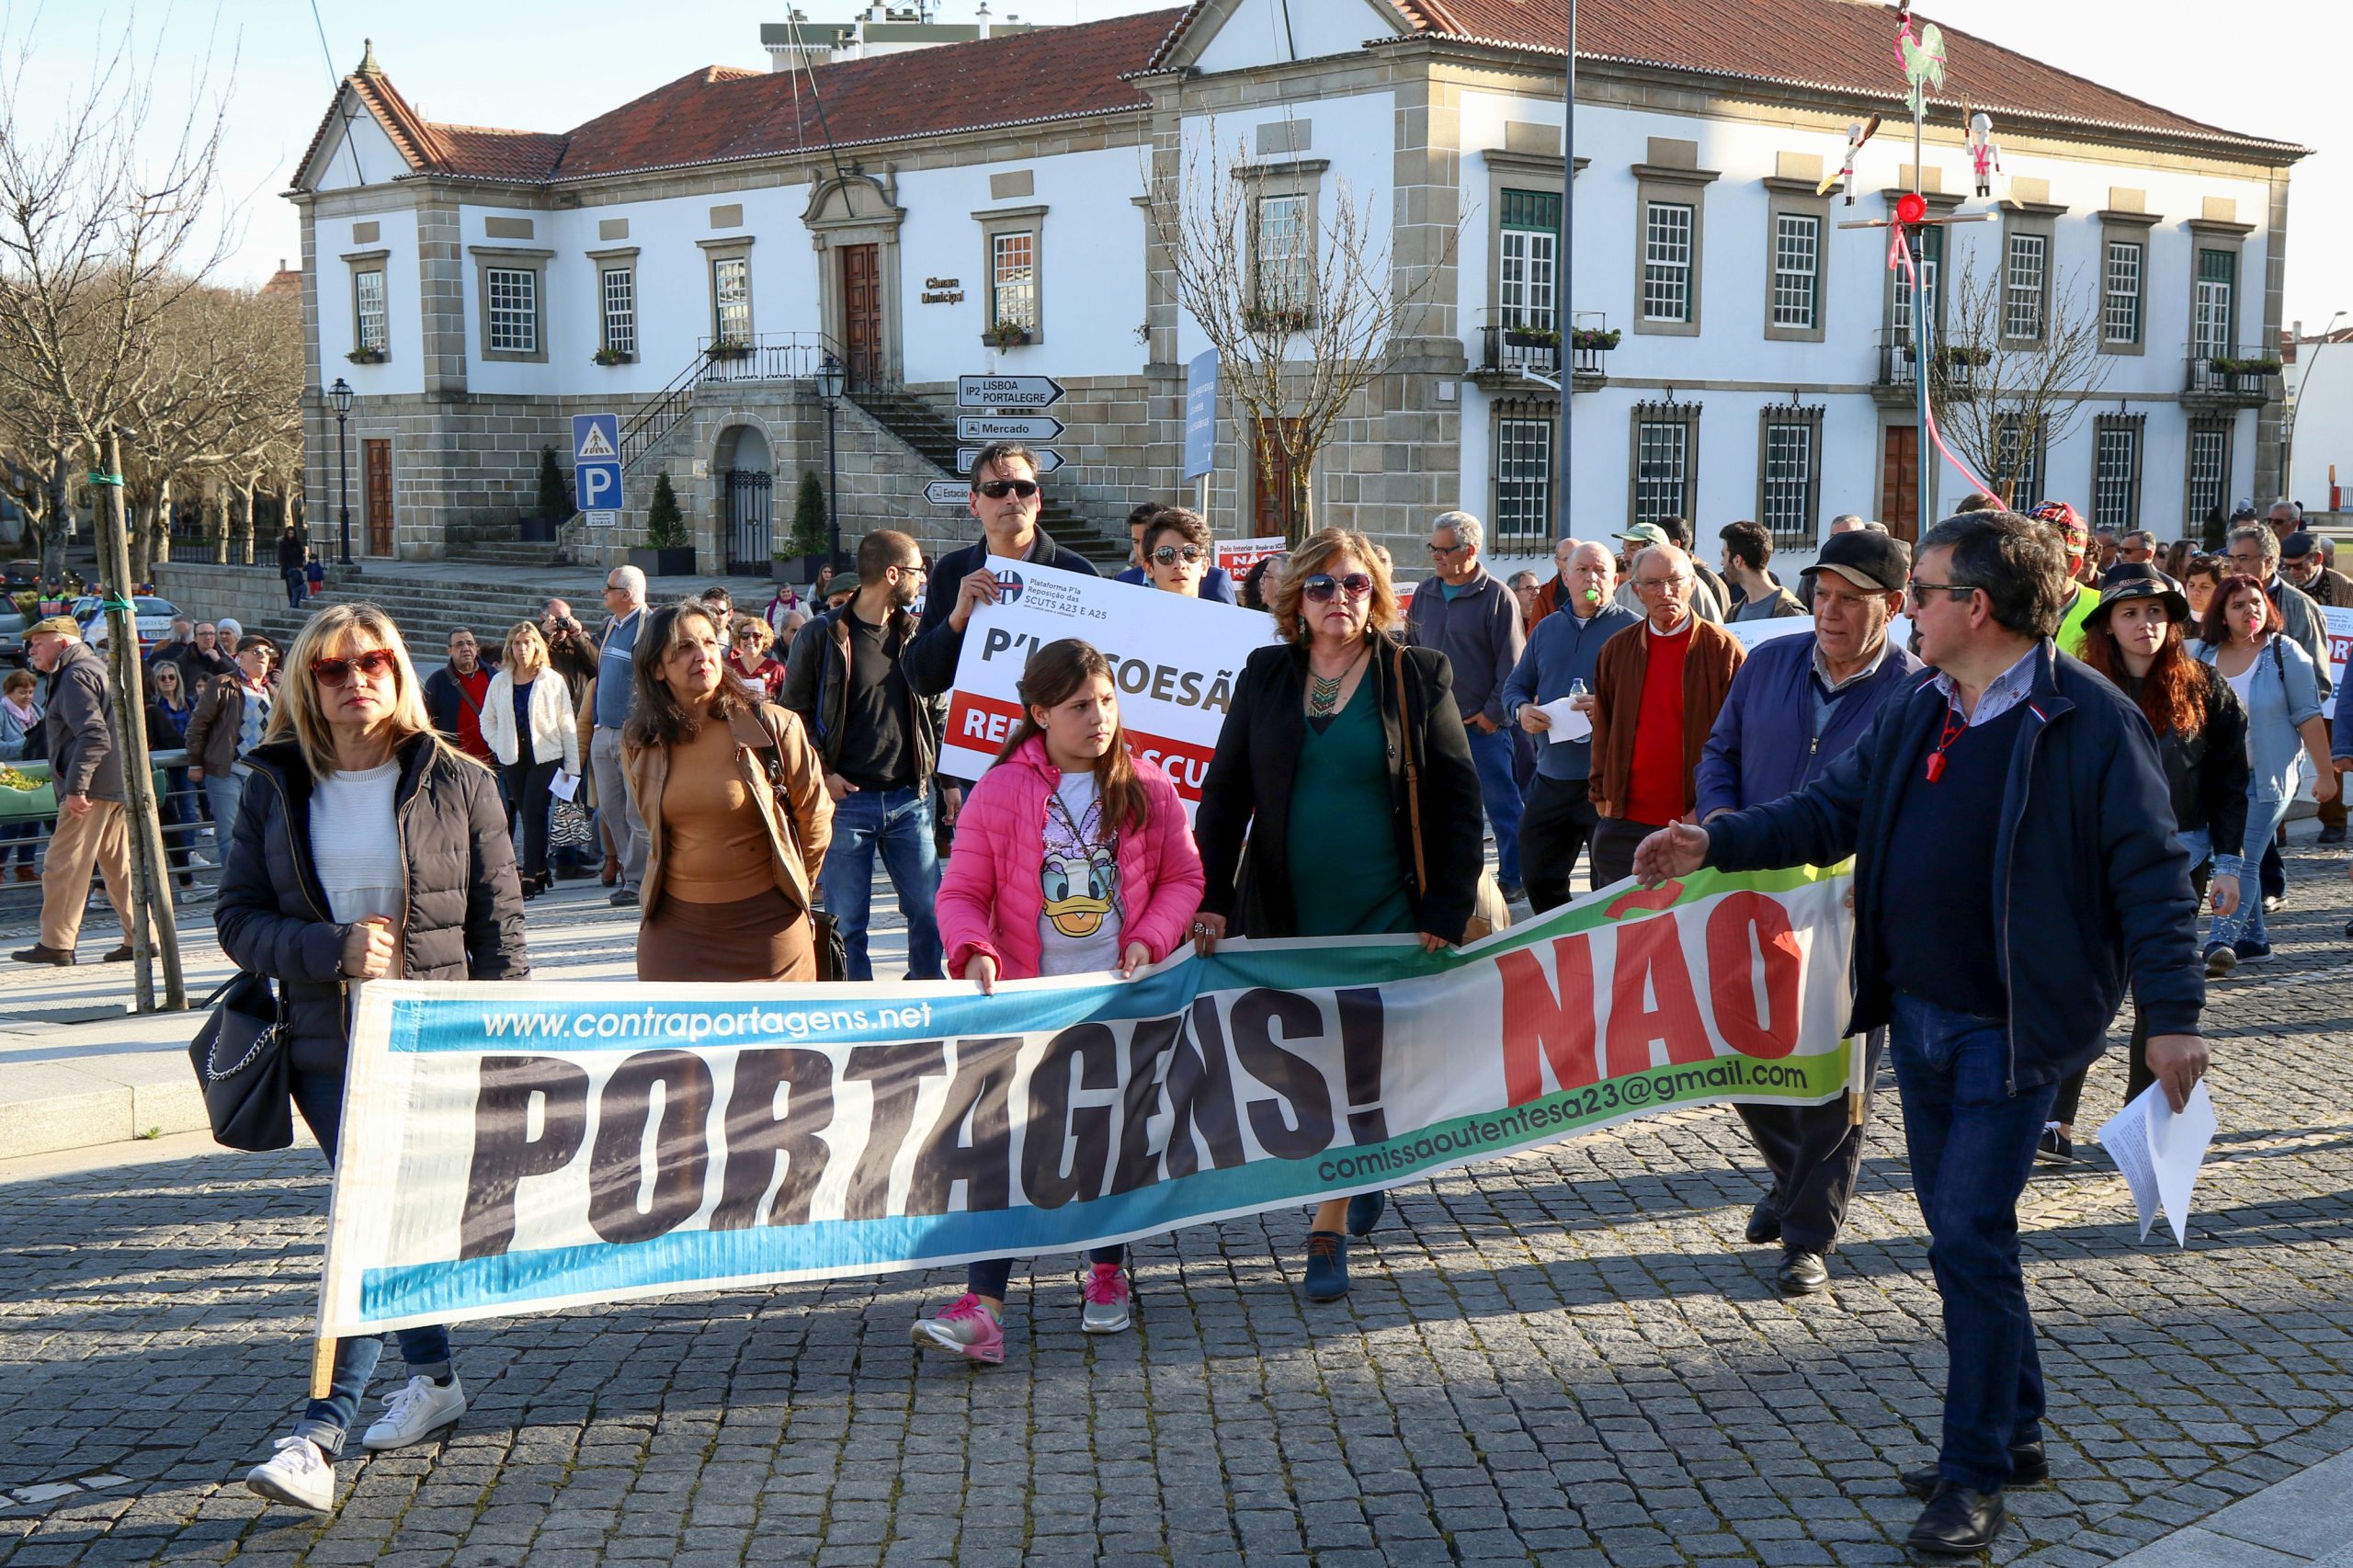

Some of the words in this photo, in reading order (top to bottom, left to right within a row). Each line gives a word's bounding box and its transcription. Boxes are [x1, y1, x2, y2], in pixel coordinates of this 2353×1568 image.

[926, 277, 959, 290] Câmara
[921, 290, 964, 305] Municipal
[966, 386, 981, 396] IP2
[983, 381, 1018, 391] LISBOA
[983, 392, 1046, 403] PORTALEGRE
[982, 424, 1029, 434] Mercado
[585, 468, 611, 506] P
[943, 488, 969, 501] Estação
[1027, 585, 1065, 600] Reposição
[1066, 592, 1080, 603] das
[1029, 578, 1067, 593] Plataforma
[1068, 585, 1082, 596] P'la
[1025, 595, 1058, 609] SCUTS
[1058, 603, 1078, 614] A23
[1079, 607, 1086, 616] E
[1087, 608, 1108, 620] A25
[483, 1002, 933, 1040] www.contraportagens.net
[460, 986, 1390, 1261] PORTAGENS!
[1495, 879, 1802, 1108] NÃO
[1317, 1059, 1809, 1183] comissaoutentesa23@gmail.com
